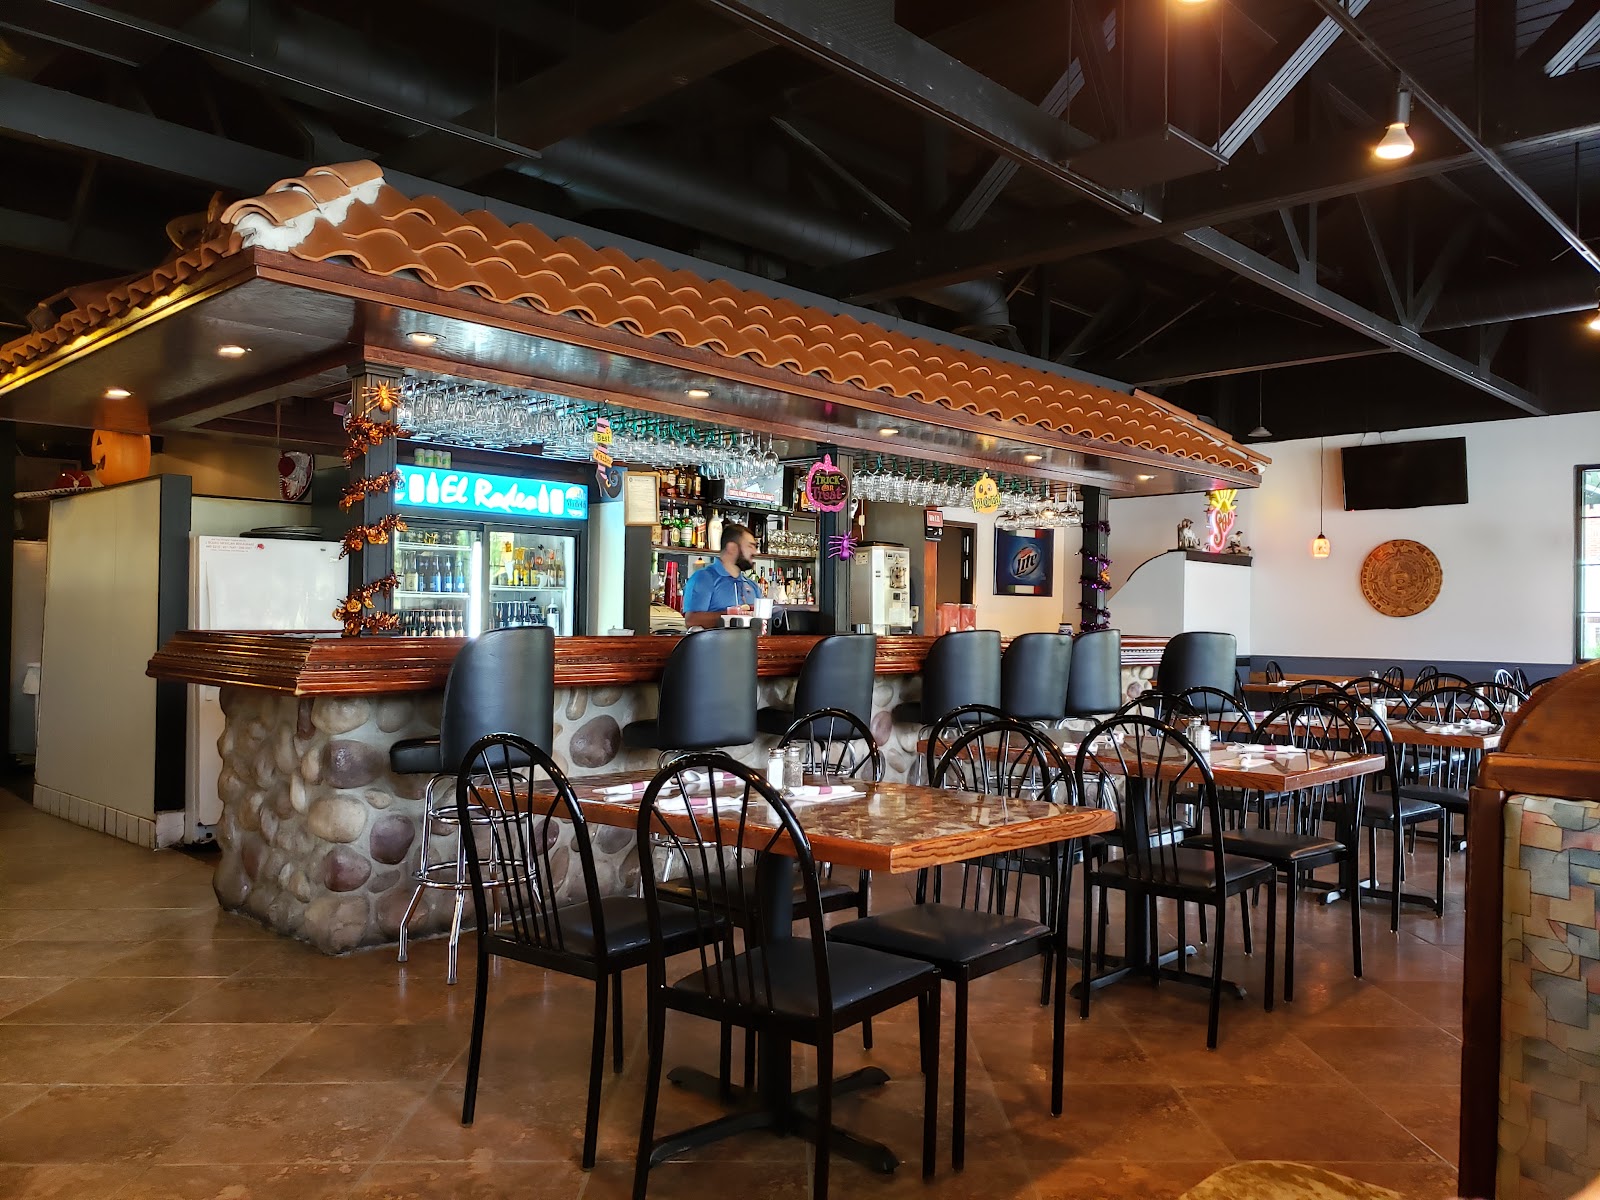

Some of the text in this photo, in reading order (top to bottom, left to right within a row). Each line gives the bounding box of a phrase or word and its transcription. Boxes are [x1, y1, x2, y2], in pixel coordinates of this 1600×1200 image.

[440, 475, 468, 504] El
[815, 475, 841, 485] TRICK
[1014, 553, 1038, 577] Lite
